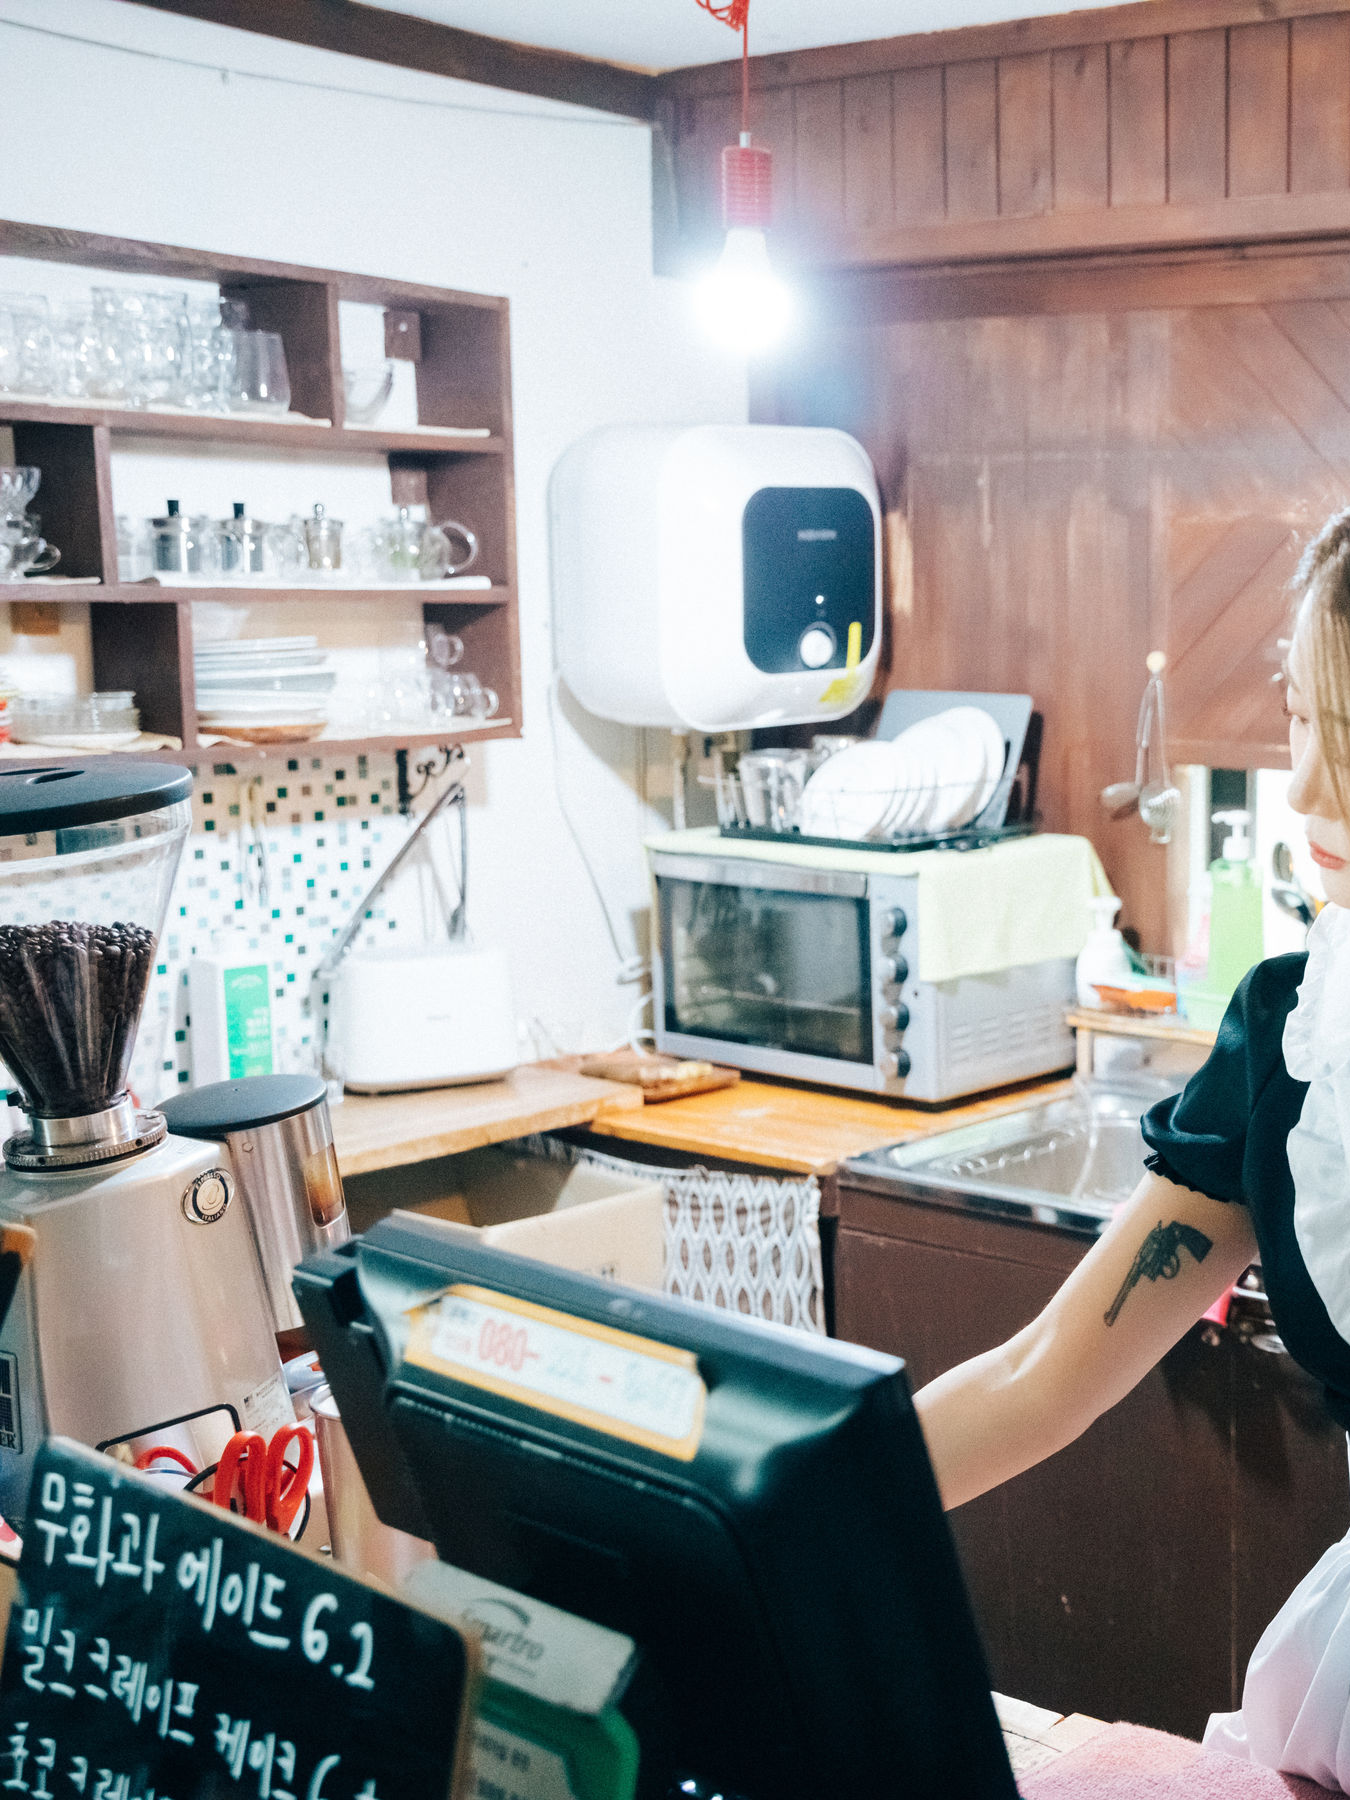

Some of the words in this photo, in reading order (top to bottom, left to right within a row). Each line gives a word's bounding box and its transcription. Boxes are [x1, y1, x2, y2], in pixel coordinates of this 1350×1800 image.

[35, 1471, 166, 1594] 무화과
[176, 1537, 291, 1650] 에이드
[302, 1592, 375, 1692] 6.2
